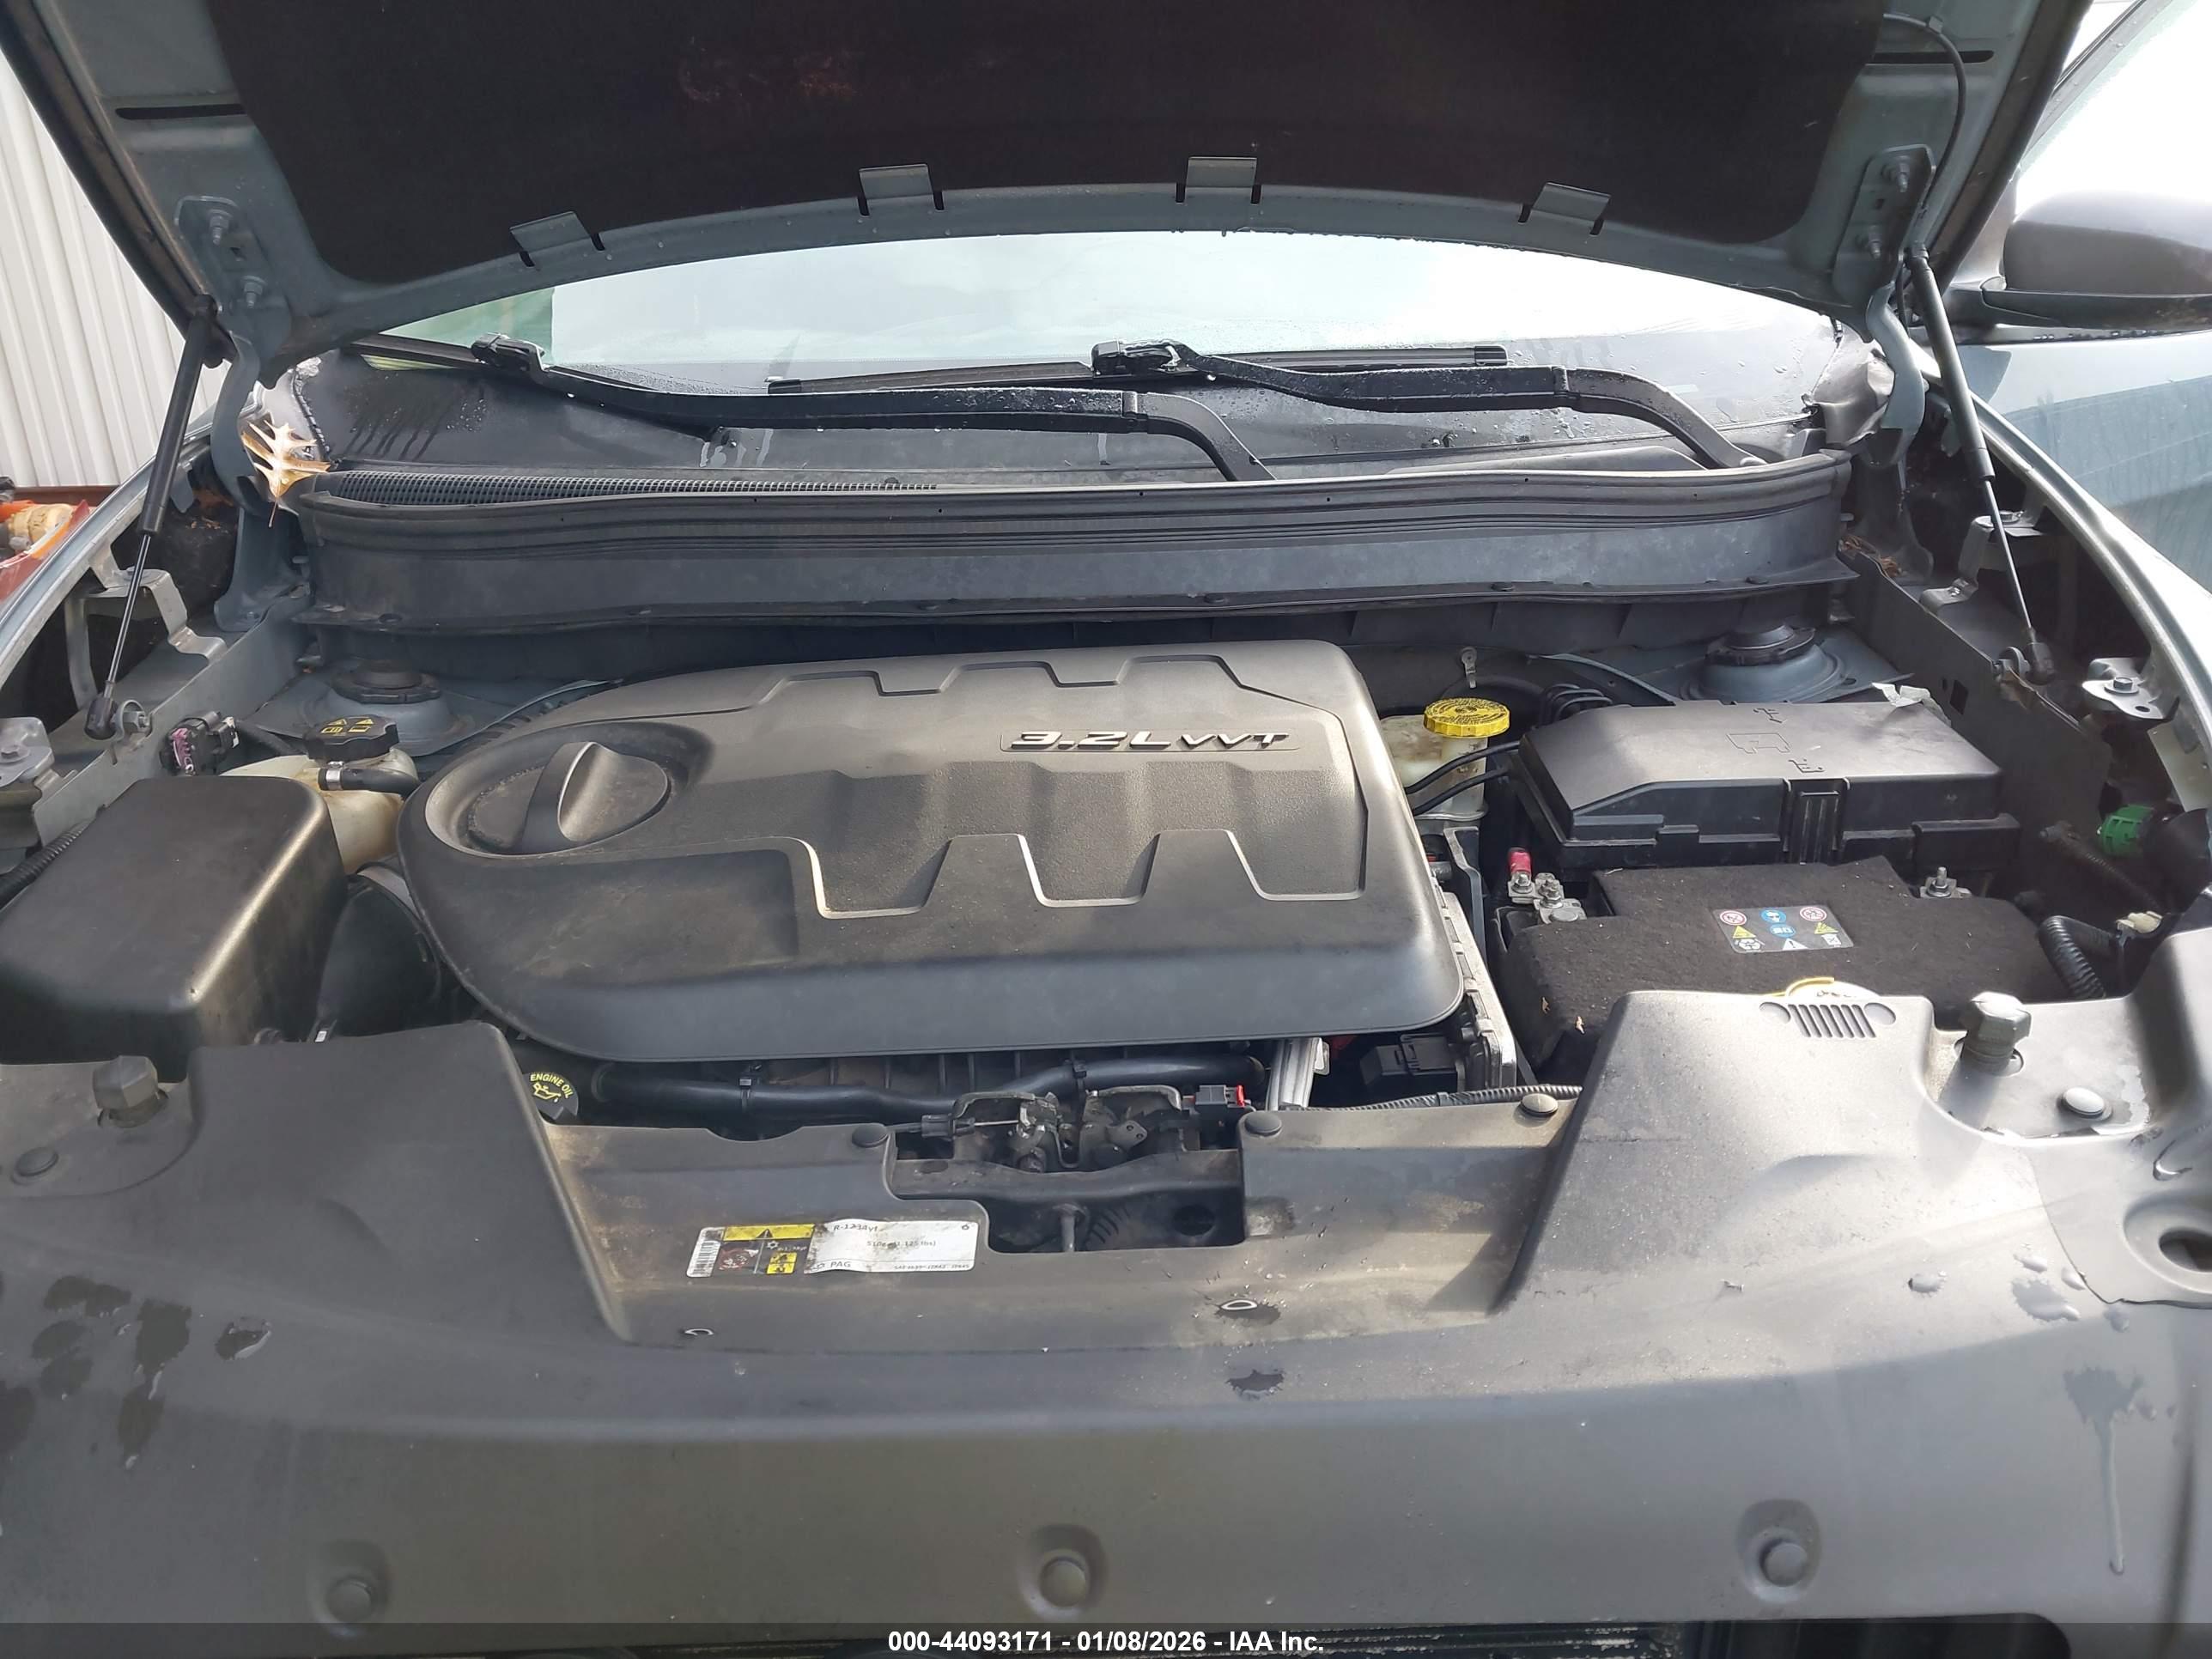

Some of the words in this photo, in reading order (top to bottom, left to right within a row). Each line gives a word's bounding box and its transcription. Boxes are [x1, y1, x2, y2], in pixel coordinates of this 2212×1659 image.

[1011, 731, 1171, 750] 3.2L
[1181, 732, 1290, 749] VVT
[530, 1073, 564, 1087] ENGINE
[561, 1085, 574, 1099] OIL
